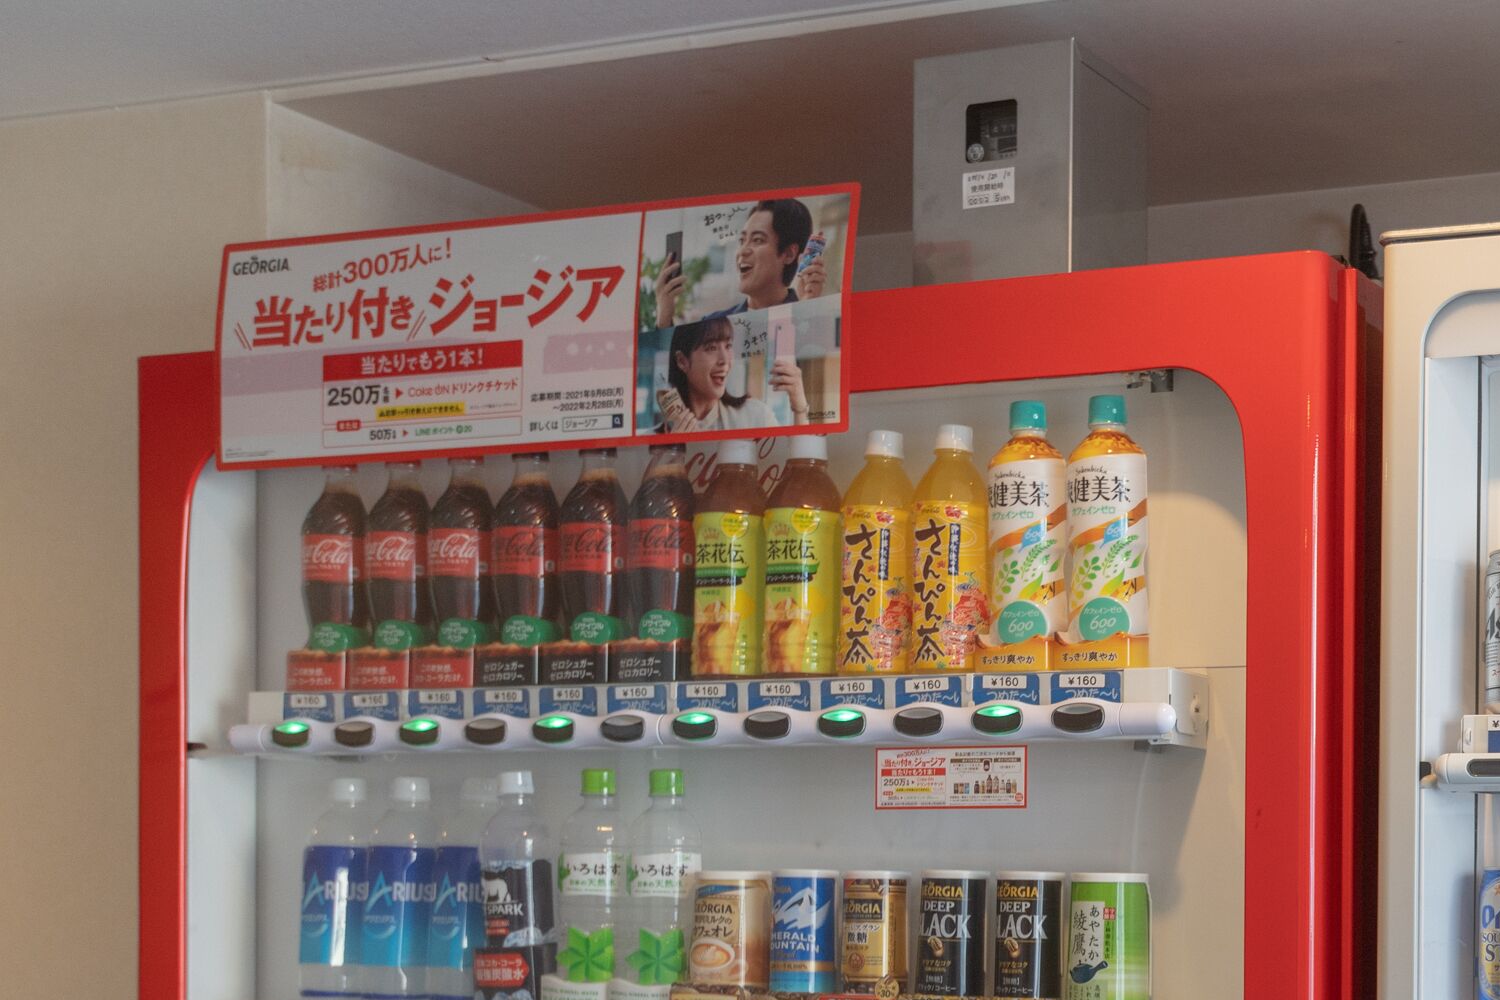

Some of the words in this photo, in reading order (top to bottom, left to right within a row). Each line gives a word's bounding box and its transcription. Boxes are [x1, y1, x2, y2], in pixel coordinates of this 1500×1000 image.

[233, 256, 290, 276] GEORGIA
[252, 286, 415, 347] 当たり付き
[428, 265, 625, 336] ジョージア
[360, 349, 483, 374] 当たりでもう1本!
[842, 523, 877, 666] さんぴん茶
[914, 518, 946, 664] さんぴん茶
[1008, 619, 1035, 632] 600
[1090, 616, 1117, 629] 600
[913, 680, 941, 690] ¥160
[991, 676, 1019, 687] ¥160
[1068, 675, 1097, 686] ¥160
[622, 687, 648, 697] ¥160
[693, 686, 719, 696] ¥160
[766, 684, 791, 694] ¥160
[838, 682, 866, 692] ¥160
[494, 691, 518, 701] ¥160
[556, 690, 581, 699] ¥160
[924, 900, 955, 912] DEEP
[1000, 901, 1031, 913] DEEP
[1088, 904, 1101, 962] あやたか
